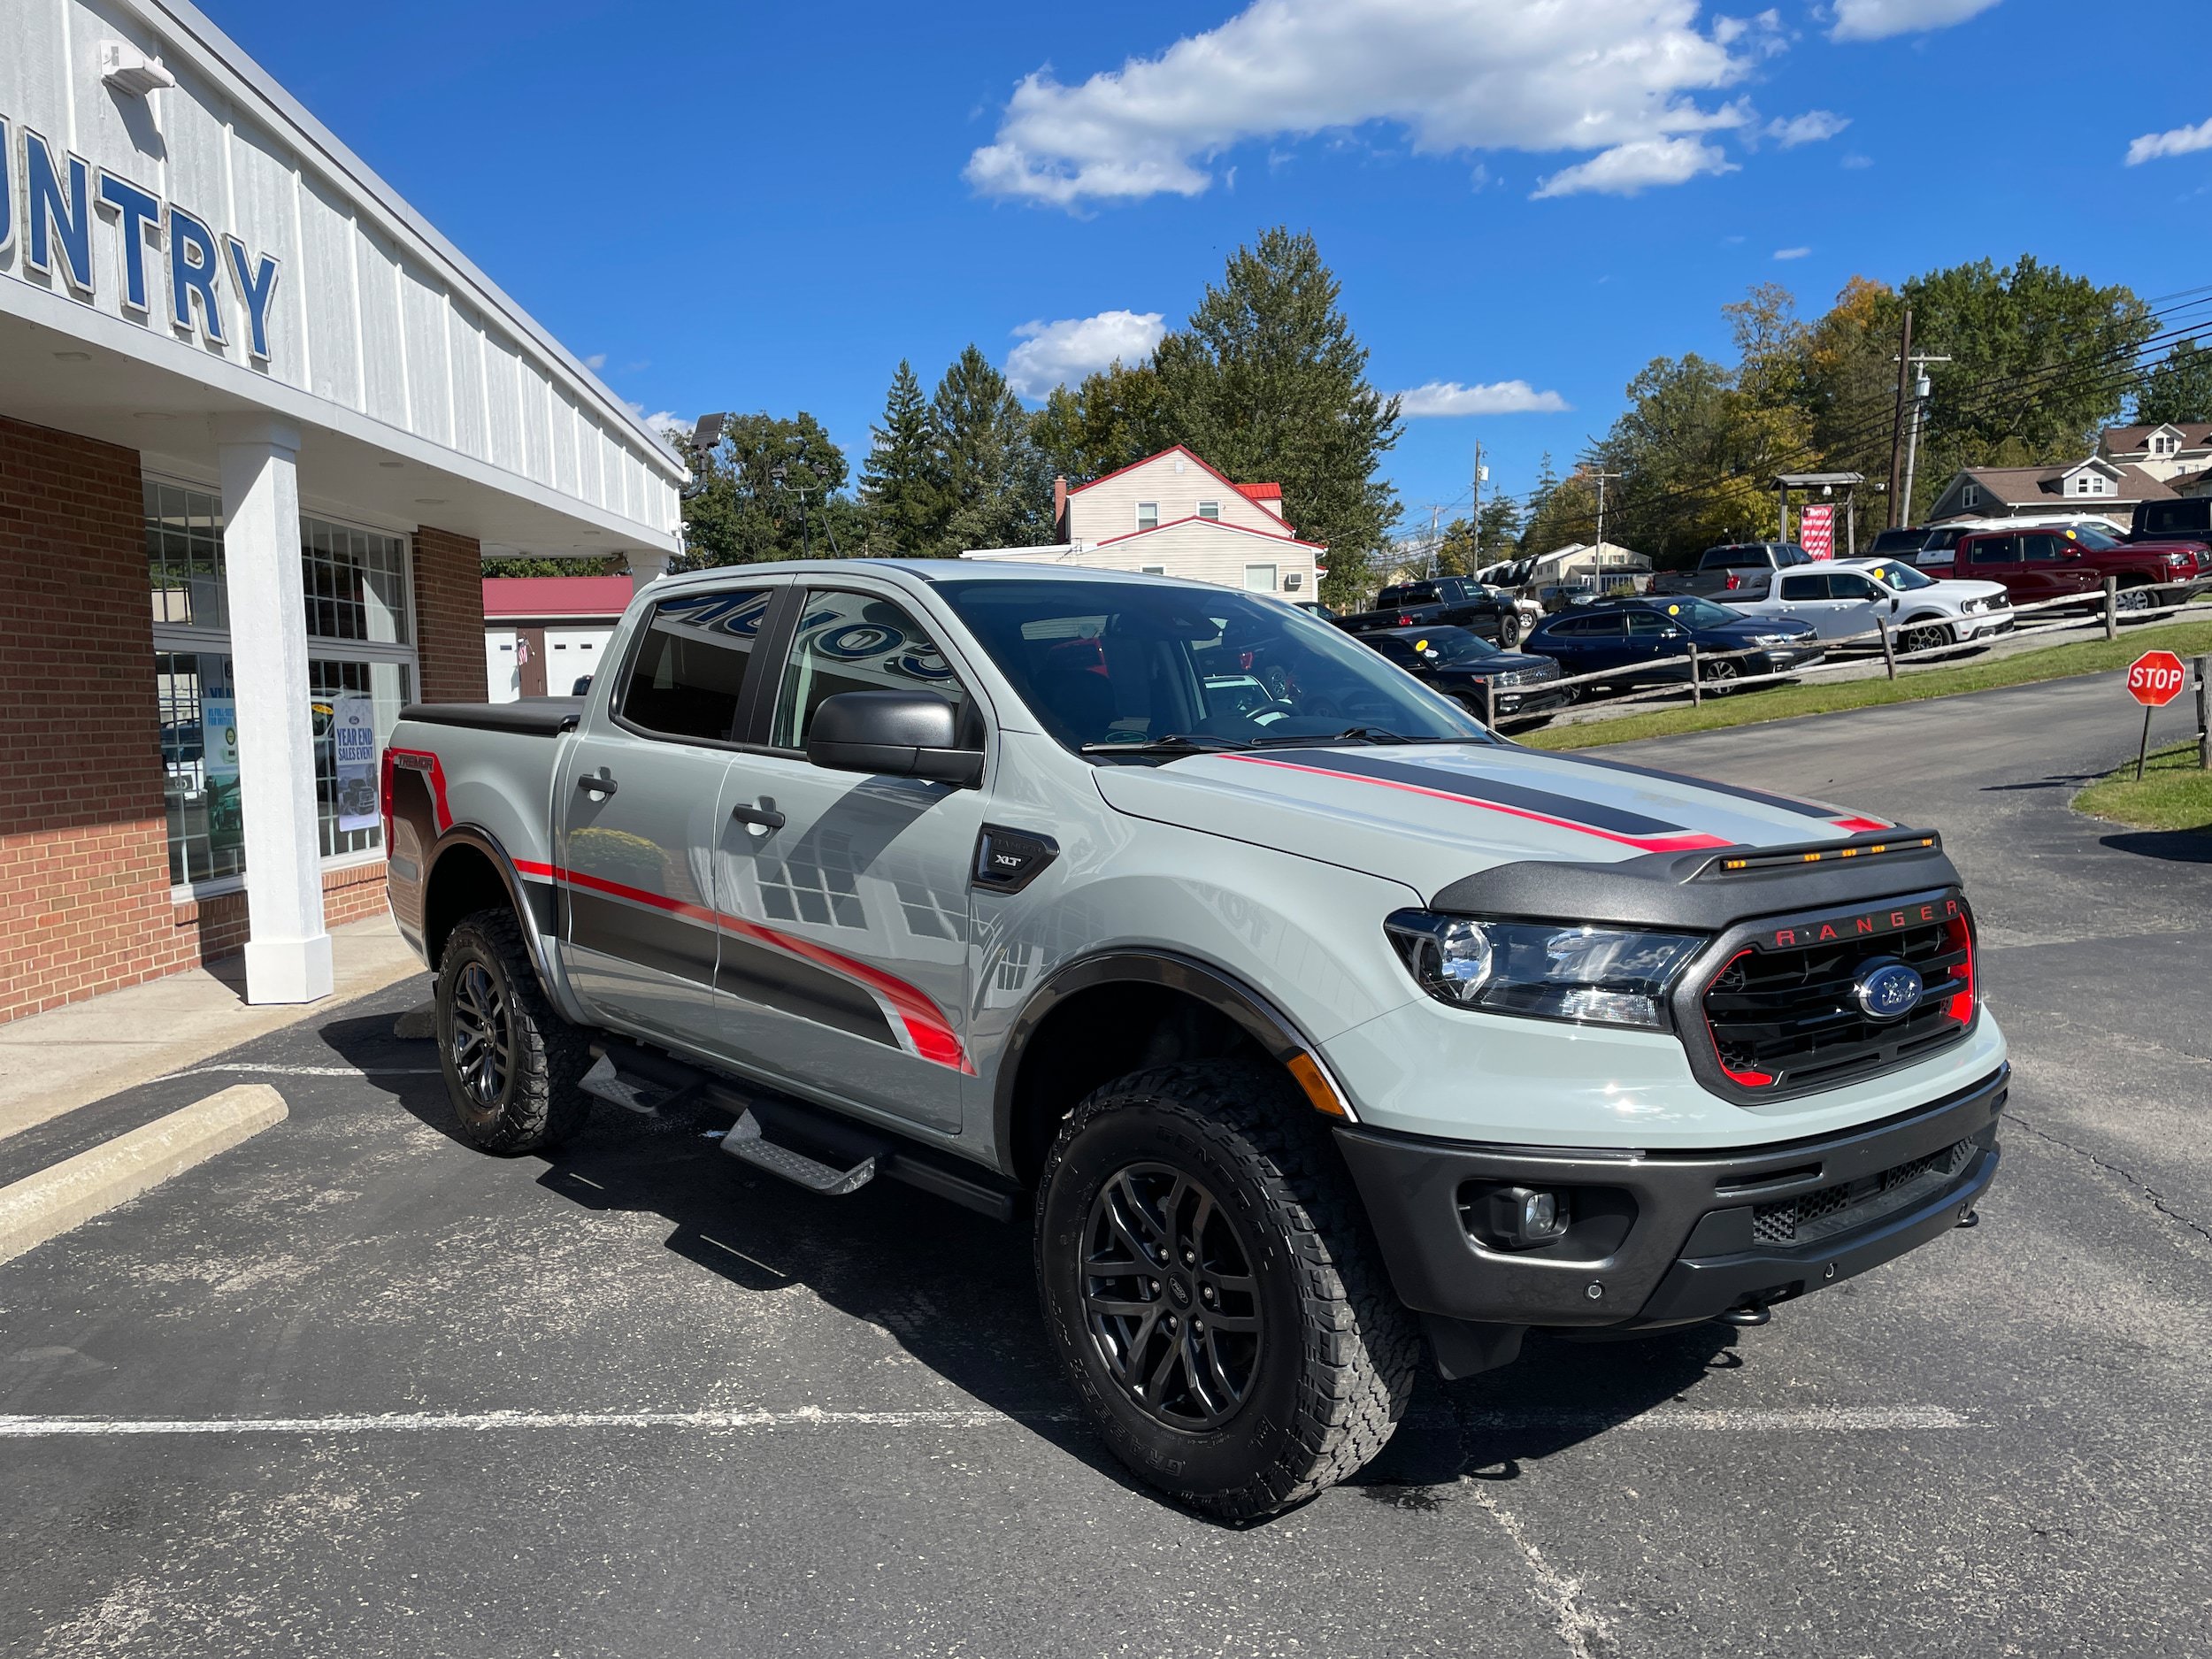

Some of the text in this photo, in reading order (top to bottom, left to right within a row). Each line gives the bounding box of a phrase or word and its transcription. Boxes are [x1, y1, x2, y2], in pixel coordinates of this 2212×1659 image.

[0, 113, 281, 362] NTRY
[2131, 666, 2182, 689] STOP
[337, 727, 373, 746] YEAR END
[338, 746, 373, 761] SALES EVENT
[398, 754, 434, 772] TREMOR
[995, 854, 1022, 867] XLT
[1776, 900, 1957, 947] RANGER
